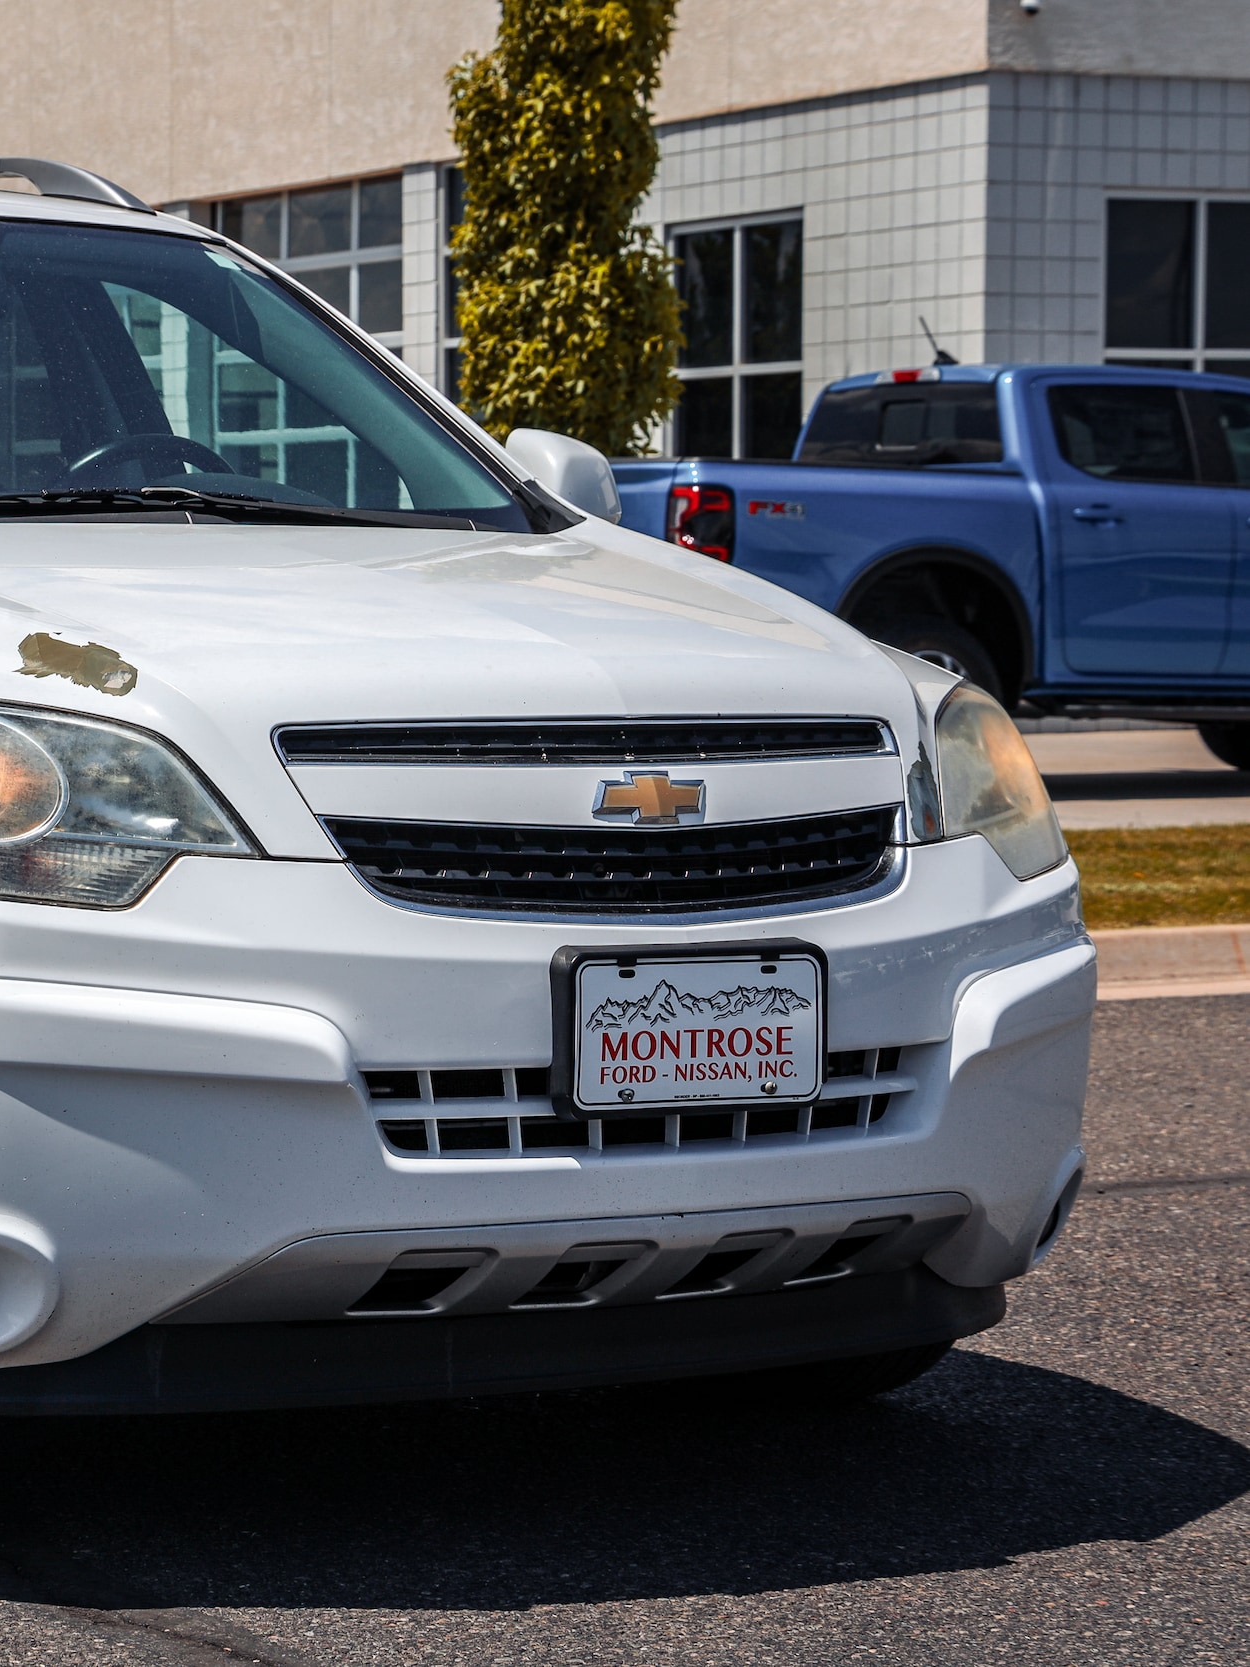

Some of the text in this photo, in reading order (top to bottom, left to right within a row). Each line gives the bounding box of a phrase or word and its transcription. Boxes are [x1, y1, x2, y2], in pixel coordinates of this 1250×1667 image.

[601, 1026, 794, 1062] MONTROSE
[600, 1065, 657, 1085] FORD
[674, 1061, 752, 1083] NISSAN,
[758, 1059, 798, 1079] INC.
